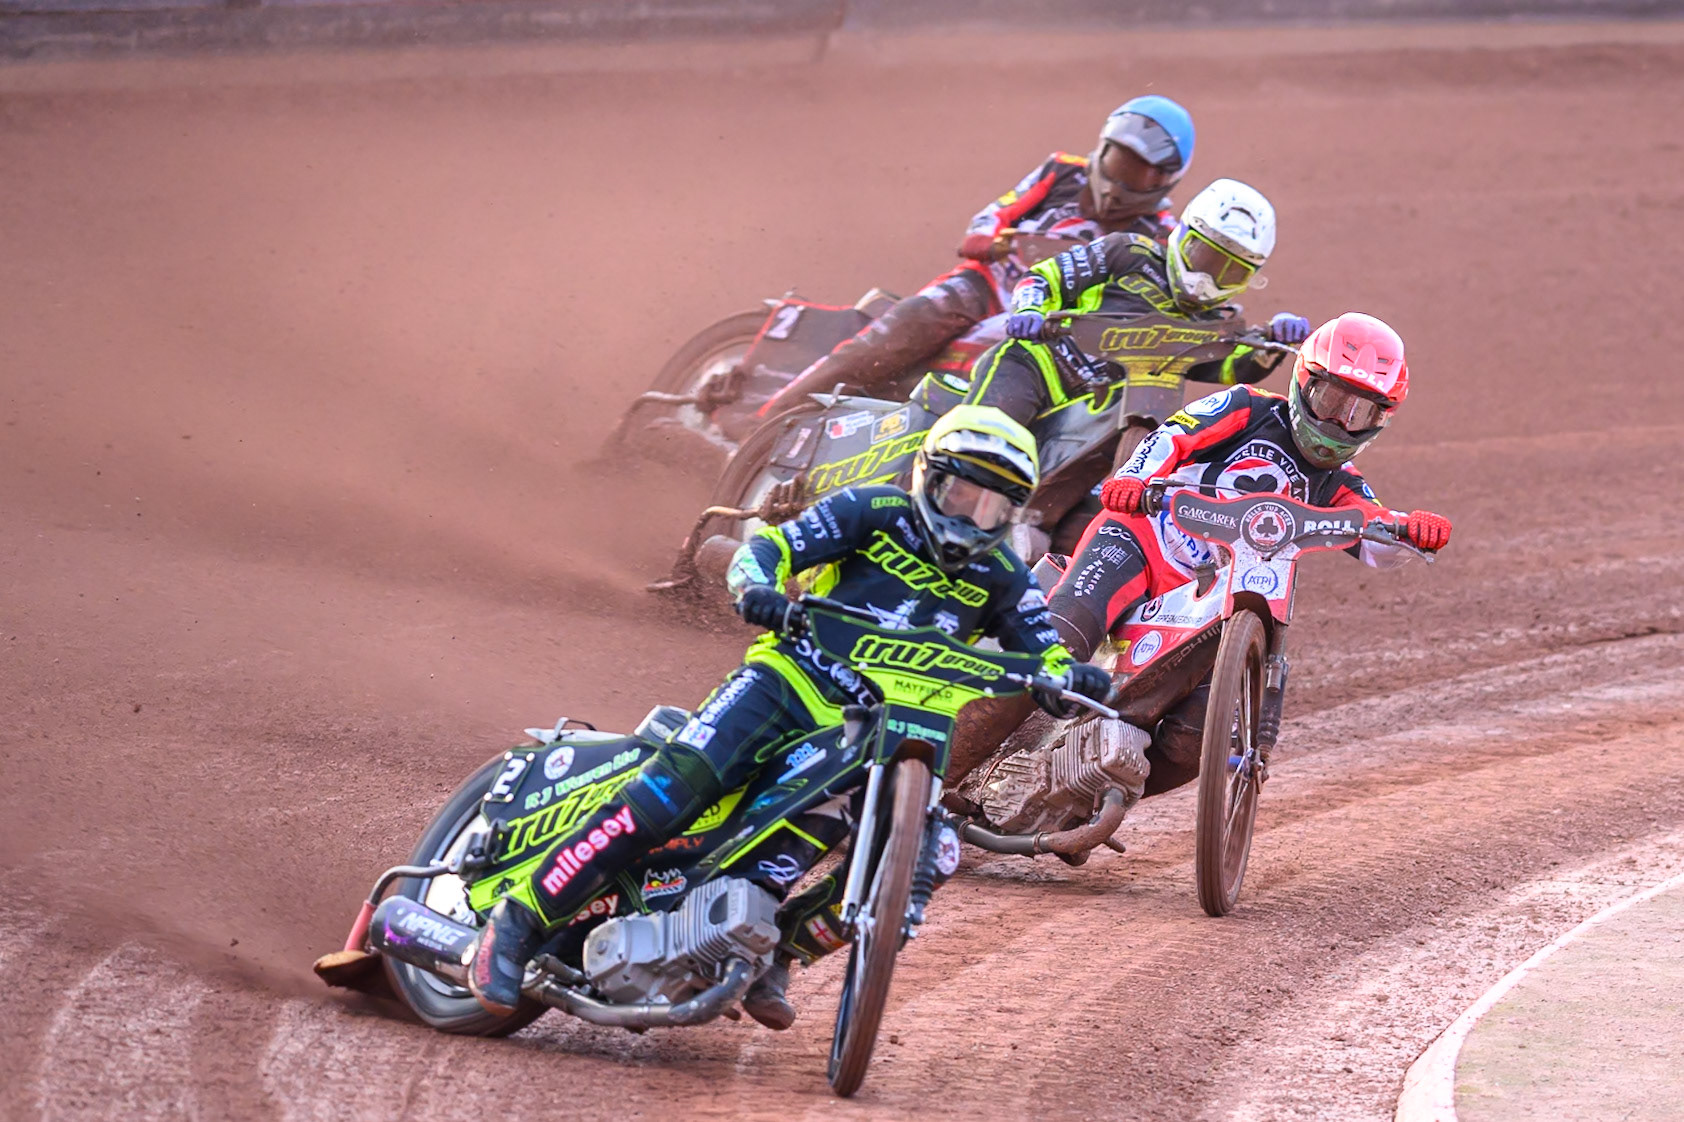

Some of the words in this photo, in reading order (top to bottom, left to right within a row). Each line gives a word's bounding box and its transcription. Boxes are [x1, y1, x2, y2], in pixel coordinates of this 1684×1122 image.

[1338, 365, 1385, 392] BOLL
[1279, 457, 1300, 483] VUE
[1303, 519, 1357, 536] BOLL
[1084, 567, 1105, 595] POINT
[1247, 574, 1273, 587] ATPI
[492, 758, 527, 795] 2
